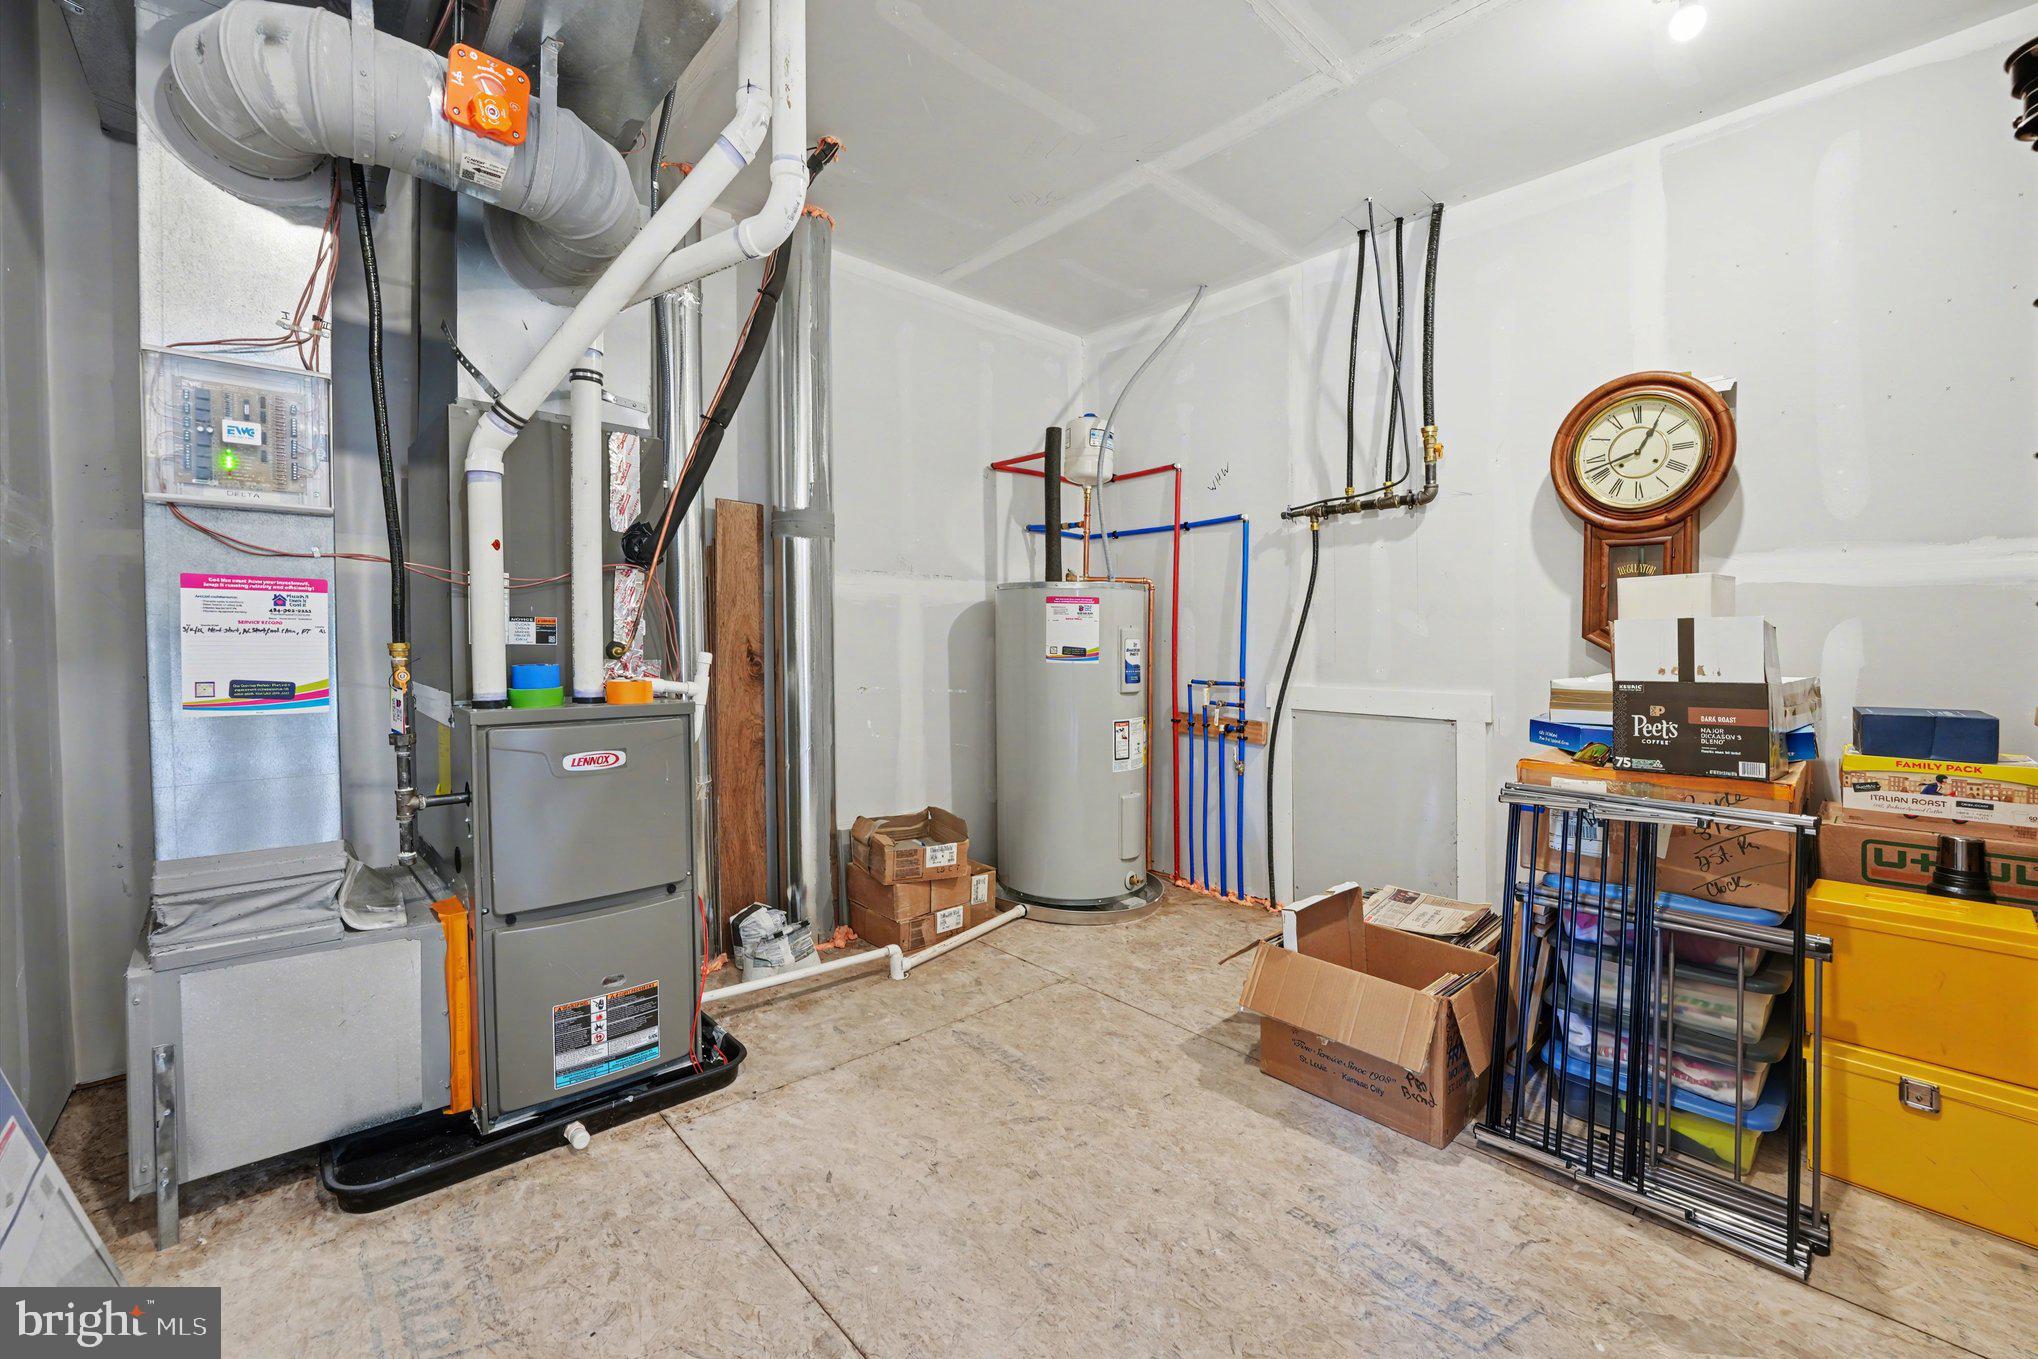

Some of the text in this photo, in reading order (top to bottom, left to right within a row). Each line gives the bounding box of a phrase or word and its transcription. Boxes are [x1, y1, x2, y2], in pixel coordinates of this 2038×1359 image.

[1631, 714, 1678, 738] Peet's
[571, 755, 610, 767] LENNOX
[1616, 757, 1631, 768] 75
[1896, 760, 1982, 774] FAMILY PACK
[1870, 794, 1947, 808] ITALIAN ROAST
